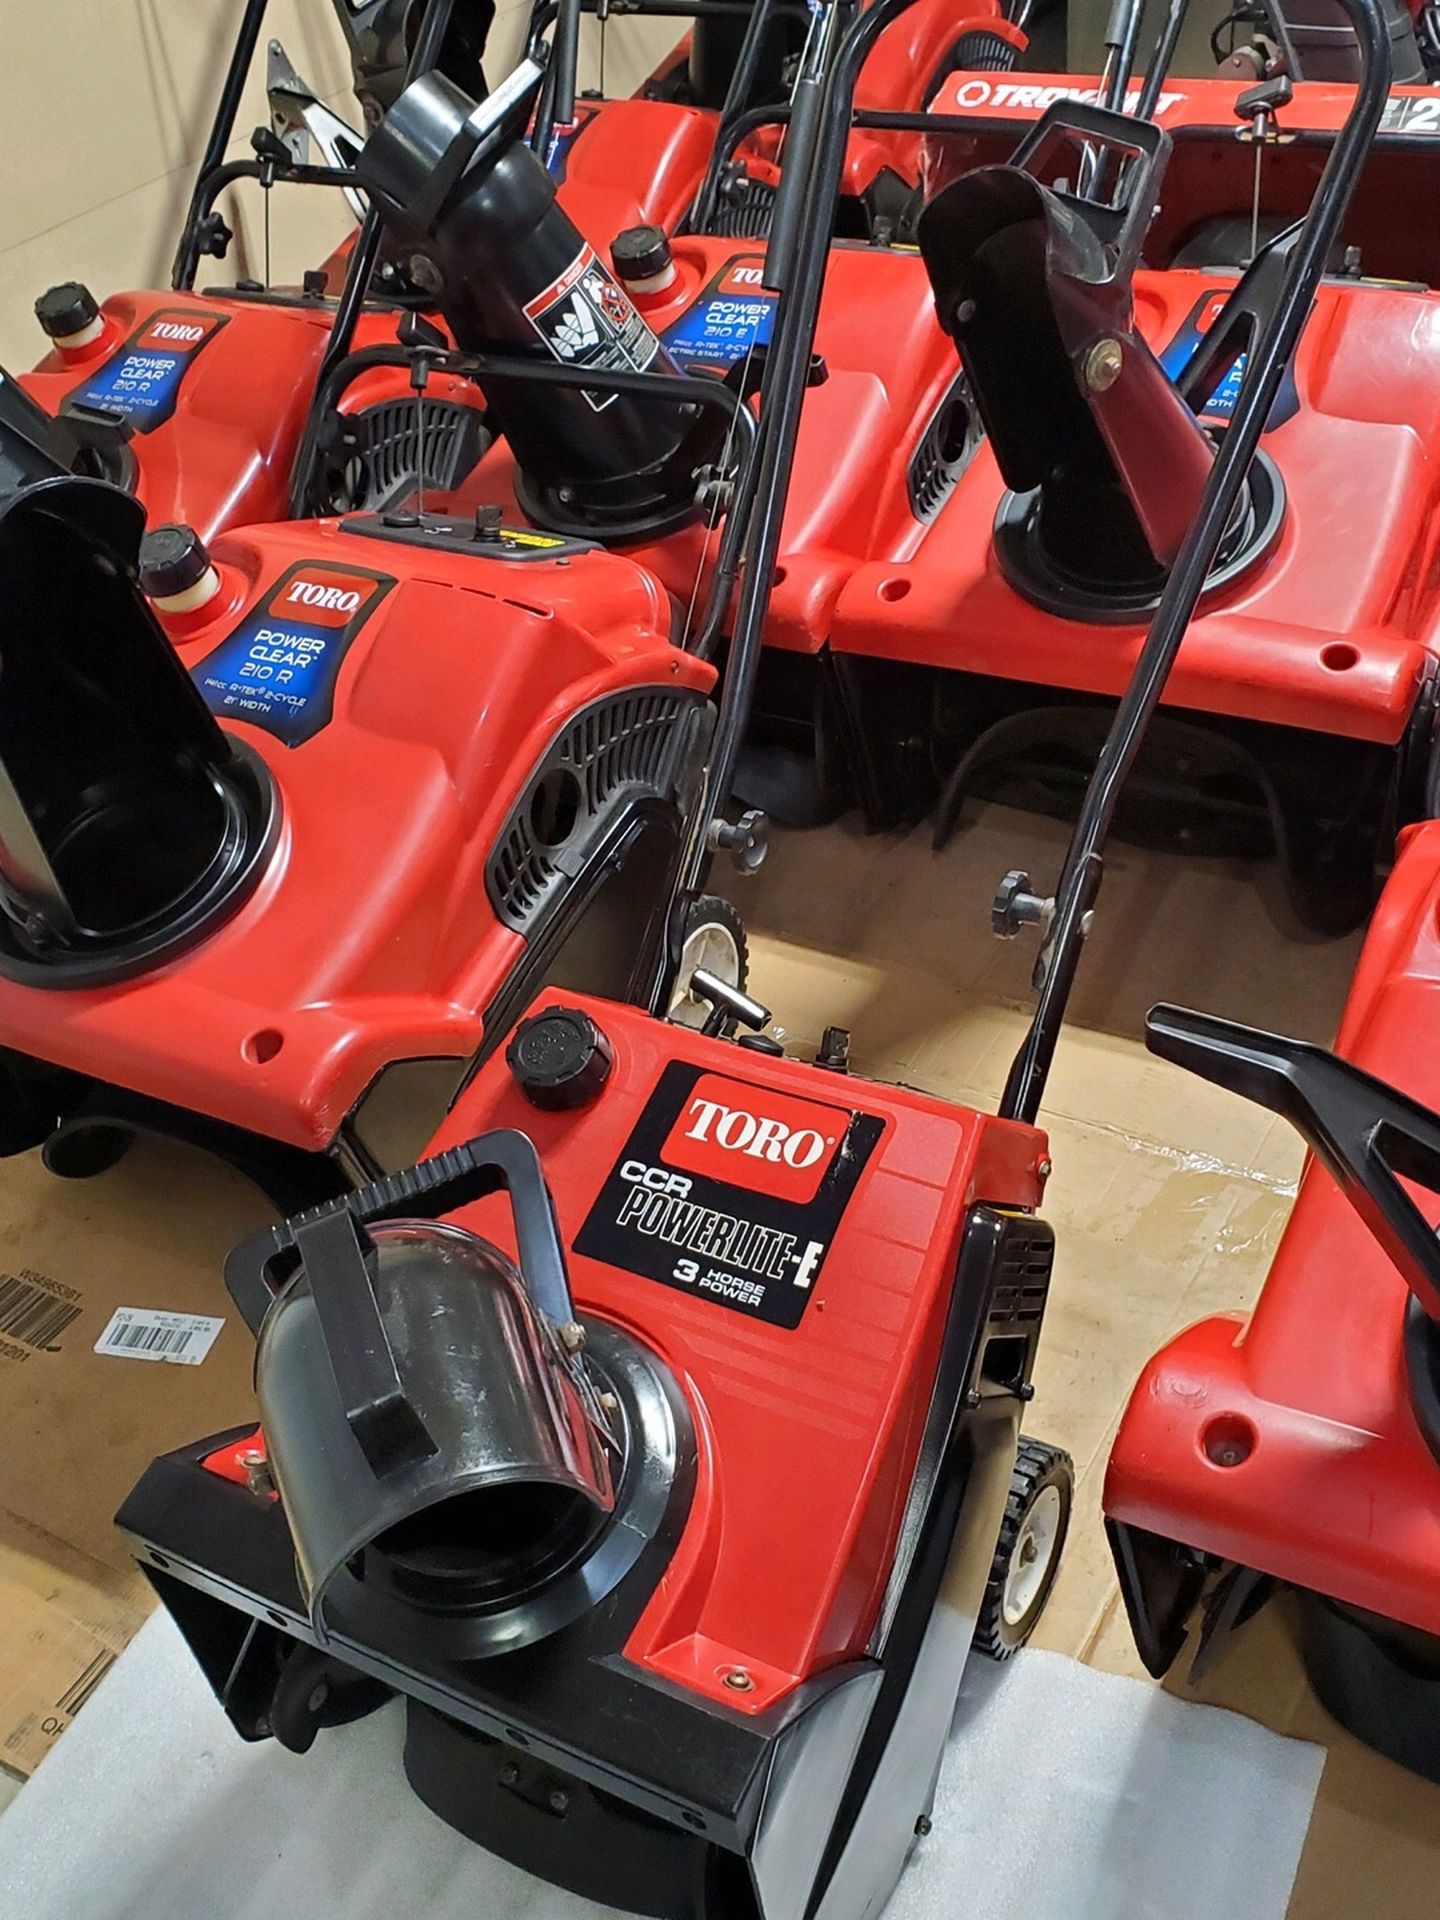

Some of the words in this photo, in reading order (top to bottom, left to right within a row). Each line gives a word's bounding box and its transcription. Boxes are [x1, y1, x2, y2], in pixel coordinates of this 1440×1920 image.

[731, 267, 764, 285] TO
[709, 301, 771, 315] POWER
[705, 312, 760, 327] CLEAR
[151, 322, 204, 341] TORO
[703, 326, 732, 337] 210
[735, 328, 748, 339] E
[124, 356, 176, 370] POWER
[120, 368, 165, 380] CLEAR
[112, 380, 136, 391] 210
[137, 382, 151, 393] R
[286, 581, 361, 612] TORO
[254, 629, 326, 654] POWER
[249, 645, 312, 669] CLEAR
[239, 662, 273, 680] 210
[275, 670, 293, 684] R
[239, 698, 272, 713] WIDTH
[684, 1098, 825, 1169] TORO
[619, 1159, 694, 1199] CCR
[616, 1184, 825, 1289] POWERLITE-E
[672, 1258, 701, 1283] 3
[706, 1268, 767, 1297] HORSE
[698, 1279, 763, 1307] POWER
